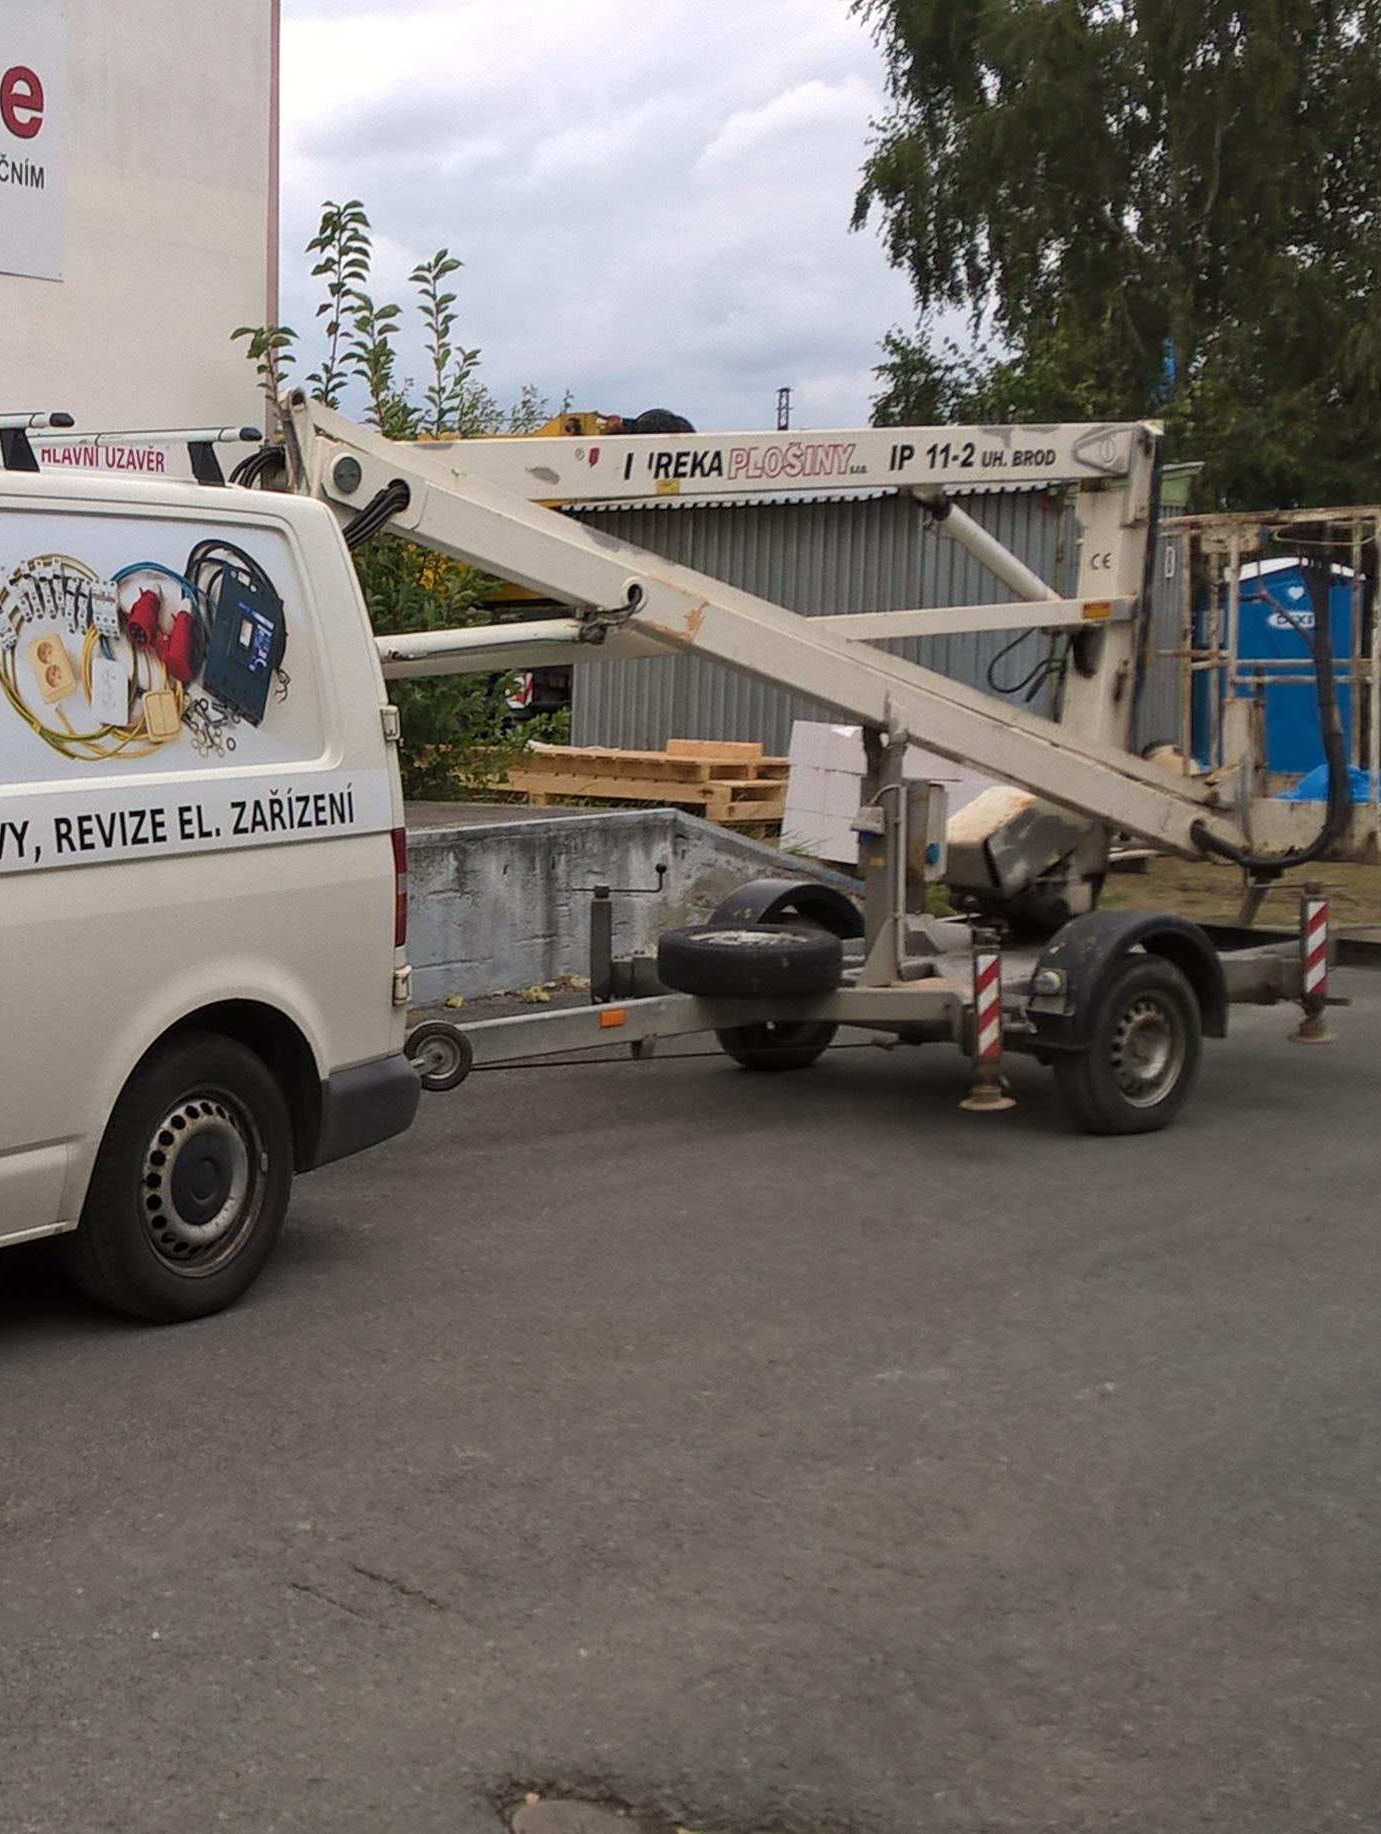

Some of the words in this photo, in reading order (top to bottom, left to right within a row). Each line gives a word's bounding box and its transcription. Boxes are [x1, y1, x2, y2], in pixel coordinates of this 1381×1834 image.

[726, 442, 857, 480] PLOŠINY
[889, 444, 915, 471] IP
[926, 442, 977, 469] 11-2
[981, 450, 1008, 468] UH.
[1011, 449, 1057, 468] BROD
[54, 808, 168, 854] REVIZE
[178, 804, 221, 841] EL.
[230, 782, 355, 836] ZAŘÍZENÍ
